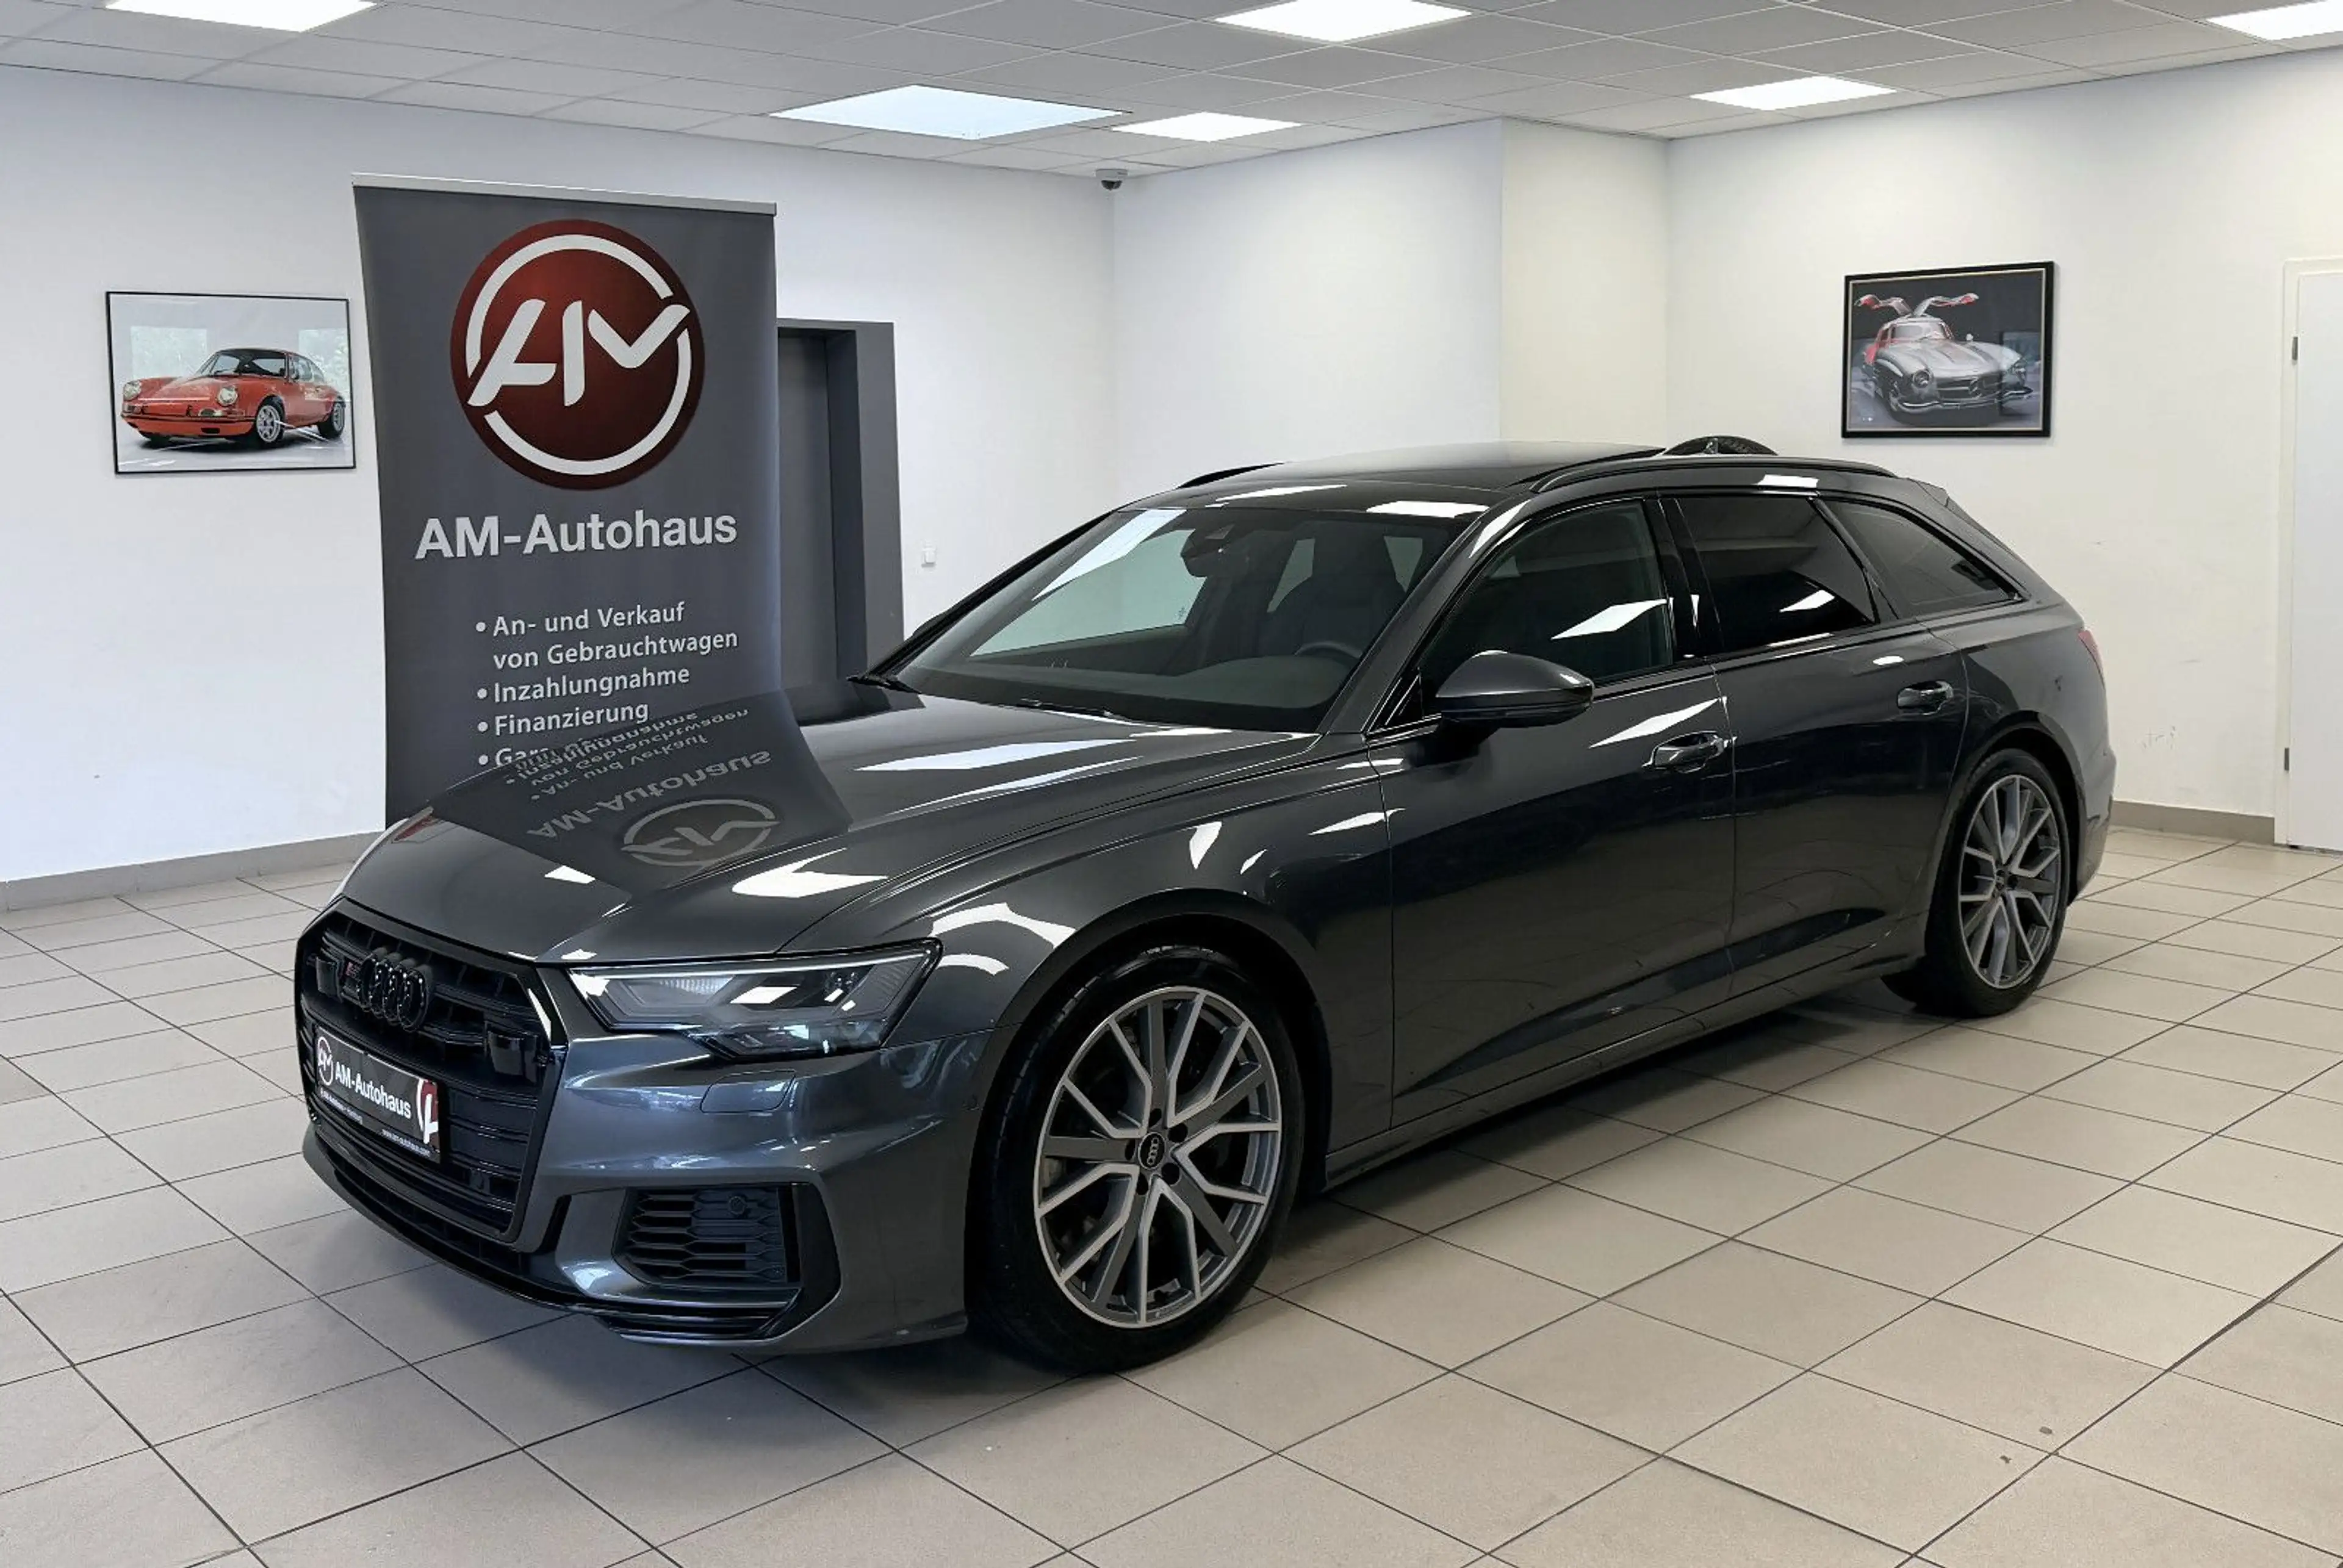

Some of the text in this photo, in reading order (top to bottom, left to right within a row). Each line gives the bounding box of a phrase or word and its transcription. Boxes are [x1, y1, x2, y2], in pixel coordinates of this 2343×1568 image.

[415, 509, 737, 559] AM-Autohaus
[493, 601, 685, 636] An- und Verkauf
[494, 631, 738, 670] von Gebrauchtwagen
[494, 666, 690, 703] Inzahlungnahme
[494, 702, 649, 736] Finanzierung
[336, 1062, 411, 1119] AM-Autohaus
